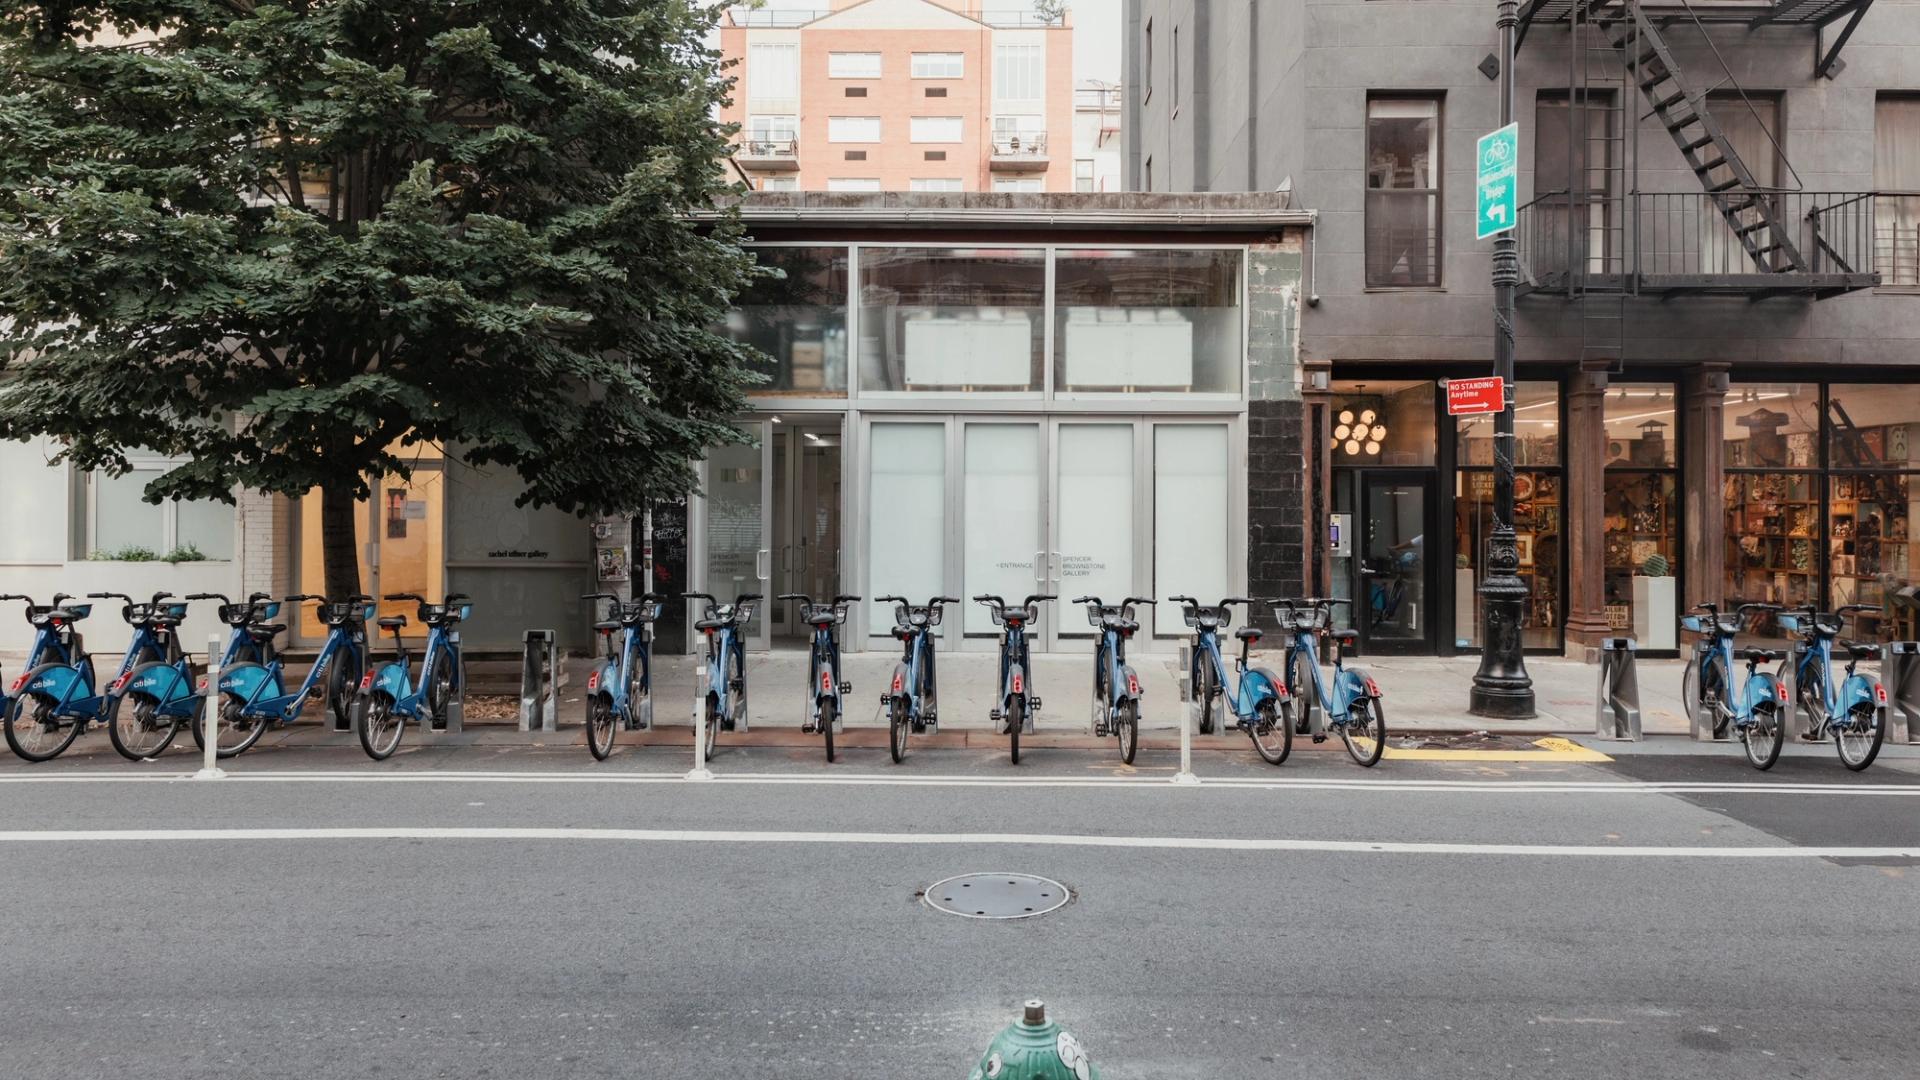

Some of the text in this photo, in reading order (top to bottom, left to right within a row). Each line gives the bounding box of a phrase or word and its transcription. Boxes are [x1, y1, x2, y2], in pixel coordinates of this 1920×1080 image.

[1479, 165, 1515, 187] Williamsburg
[1485, 184, 1506, 200] Bridge
[1460, 381, 1494, 390] STANDING
[1450, 391, 1479, 399] Anytime
[527, 550, 549, 559] gallery
